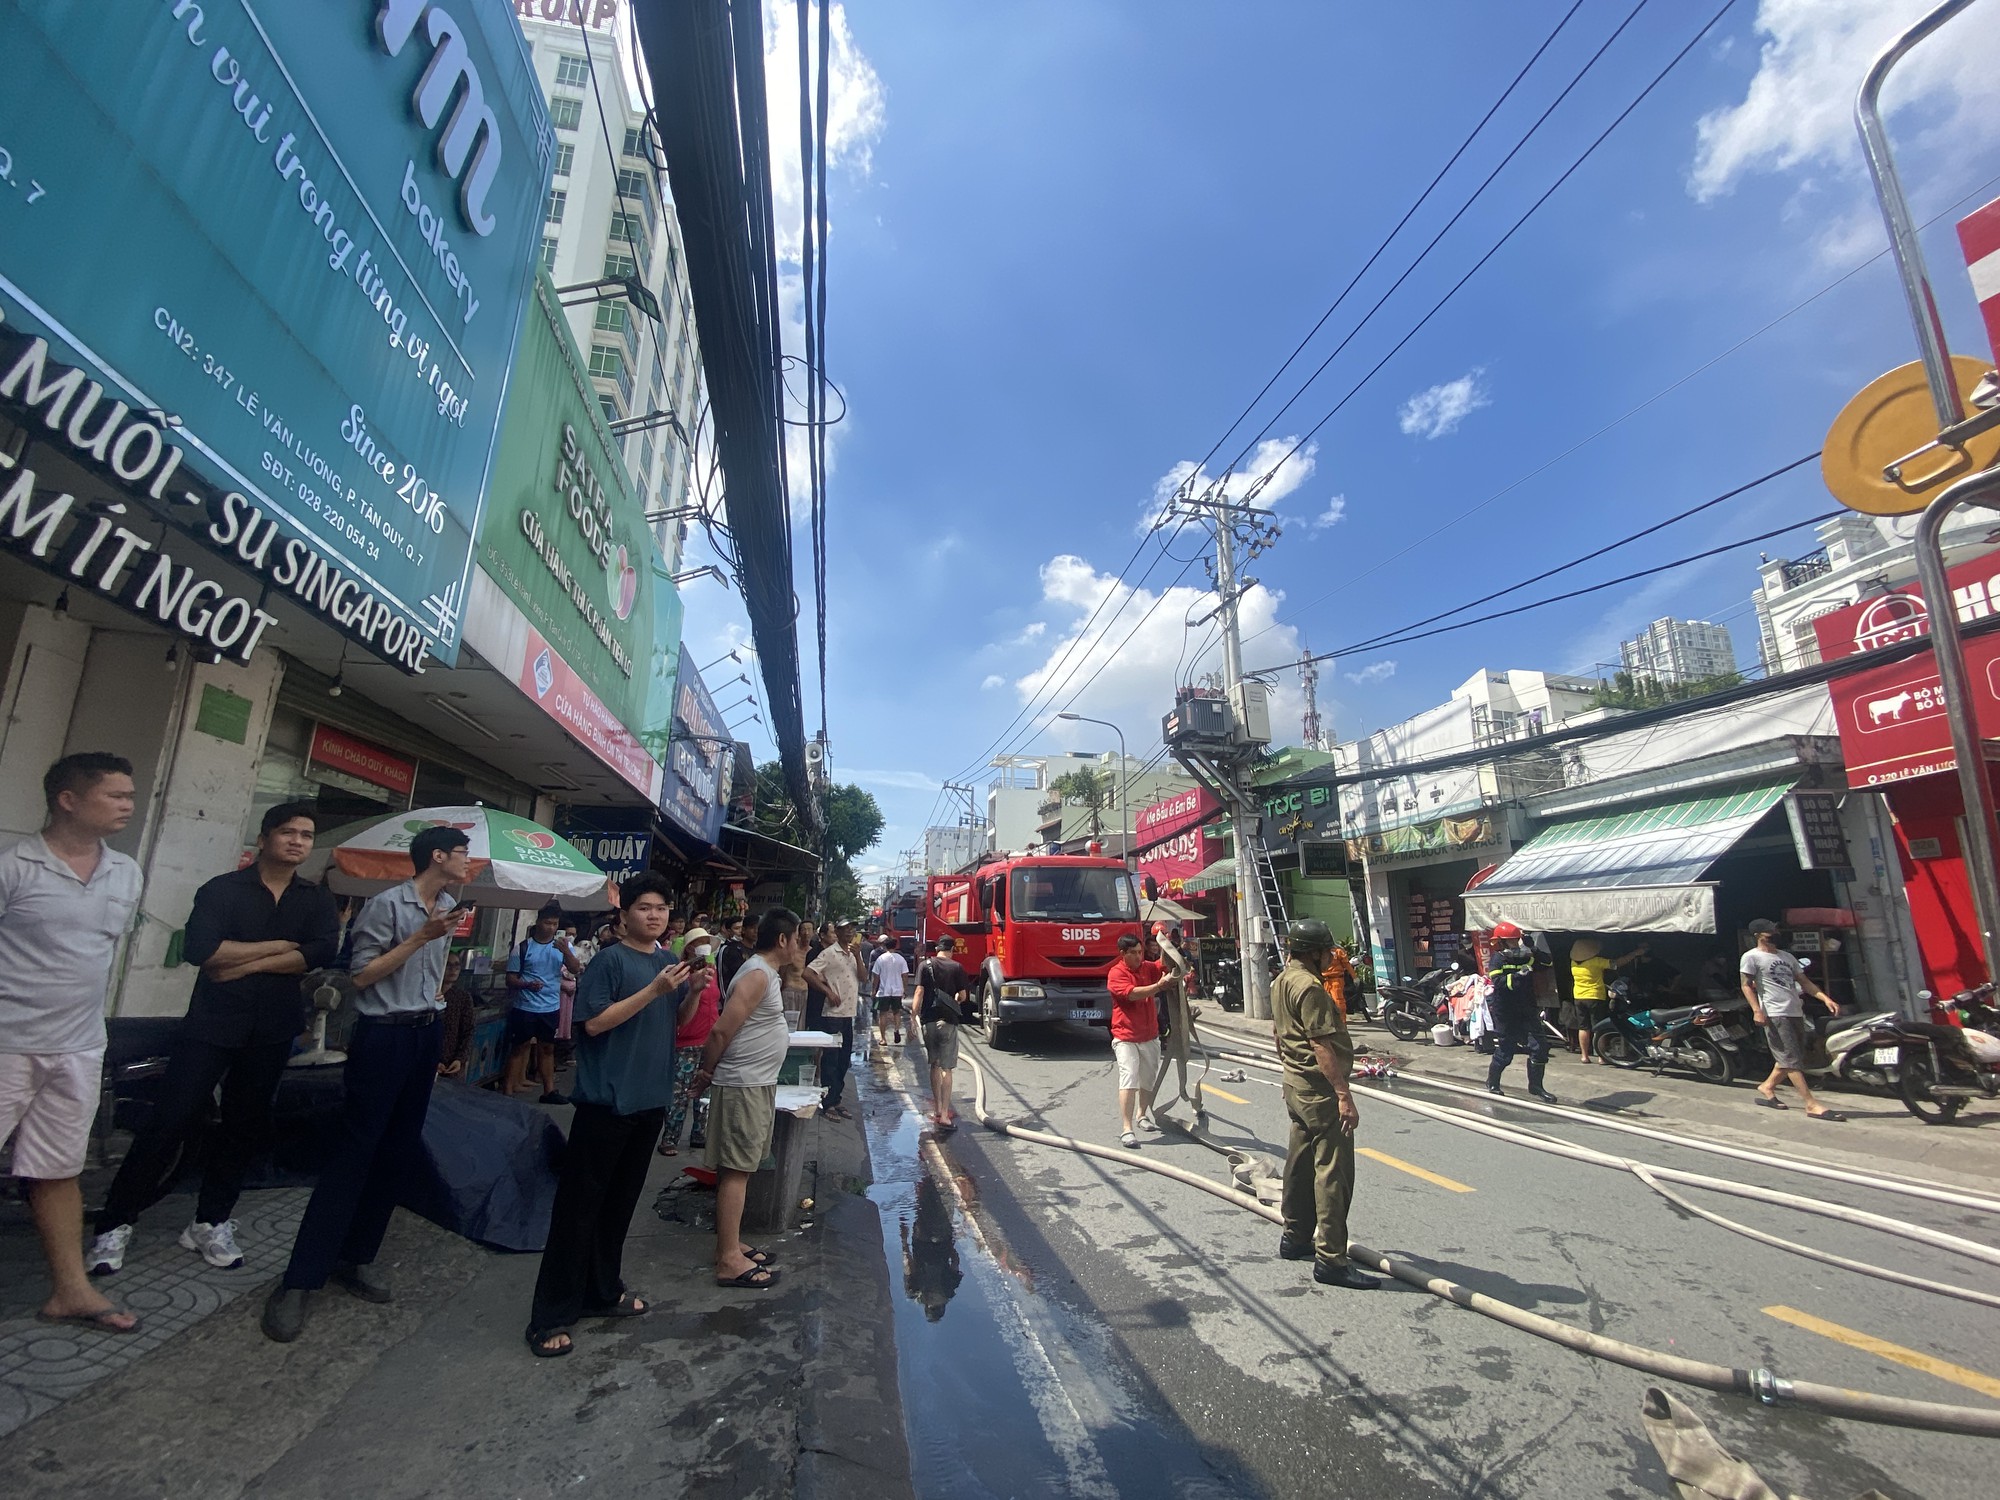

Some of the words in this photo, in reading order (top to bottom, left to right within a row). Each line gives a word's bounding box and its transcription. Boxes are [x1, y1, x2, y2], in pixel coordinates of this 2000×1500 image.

[27, 180, 46, 204] 7
[212, 46, 273, 143] vui
[275, 132, 354, 277] trong
[355, 250, 407, 349] từng
[407, 332, 430, 378] vị
[428, 363, 469, 429] ngọt
[401, 159, 480, 324] bakery
[154, 307, 199, 361] CN2:
[203, 354, 235, 389] 347
[236, 385, 259, 416] LÊ
[263, 408, 293, 448] VĂN
[295, 440, 343, 499] LƯƠNG,
[346, 488, 356, 508] P.
[359, 499, 381, 529] TÂN
[416, 554, 424, 567] 7
[340, 404, 395, 485] Since
[396, 464, 447, 534] 2016
[562, 423, 613, 539] SATRA
[0, 337, 184, 500] MUỐI
[209, 492, 279, 569] SU
[273, 538, 434, 674] SINGAPORE
[261, 451, 295, 491] SĐT:
[298, 483, 322, 512] 028
[322, 505, 345, 532] 220
[345, 523, 365, 549] 054
[366, 542, 380, 561] 34
[557, 459, 612, 570] FOODS
[521, 508, 544, 555] CỬA
[545, 541, 572, 593] HÀNG
[71, 503, 151, 590] ÍT
[136, 554, 279, 664] NGỌT
[1913, 687, 1931, 701] BÒ
[1933, 686, 1944, 696] M
[1916, 698, 1934, 711] BÒ
[1936, 695, 1945, 706] Ú
[555, 694, 572, 719] CỬA
[573, 709, 592, 737] HÀNG
[322, 740, 343, 757] KÍNH
[344, 749, 367, 767] CHÀO
[367, 759, 384, 773] QUÝ
[384, 765, 408, 783] KHÁCH
[1879, 772, 1898, 783] 320
[1899, 767, 1910, 777] LÊ
[1911, 764, 1934, 776] VĂN
[1935, 760, 1957, 770] LƯƠ
[1156, 802, 1168, 822] Bầu
[1186, 792, 1197, 811] Bé
[514, 845, 570, 861] SATRA
[519, 853, 575, 868] FOODS
[567, 833, 592, 859] ÚN
[597, 837, 647, 864] QUẬY
[1531, 896, 1558, 920] TẤM
[1061, 928, 1101, 941] SIDES
